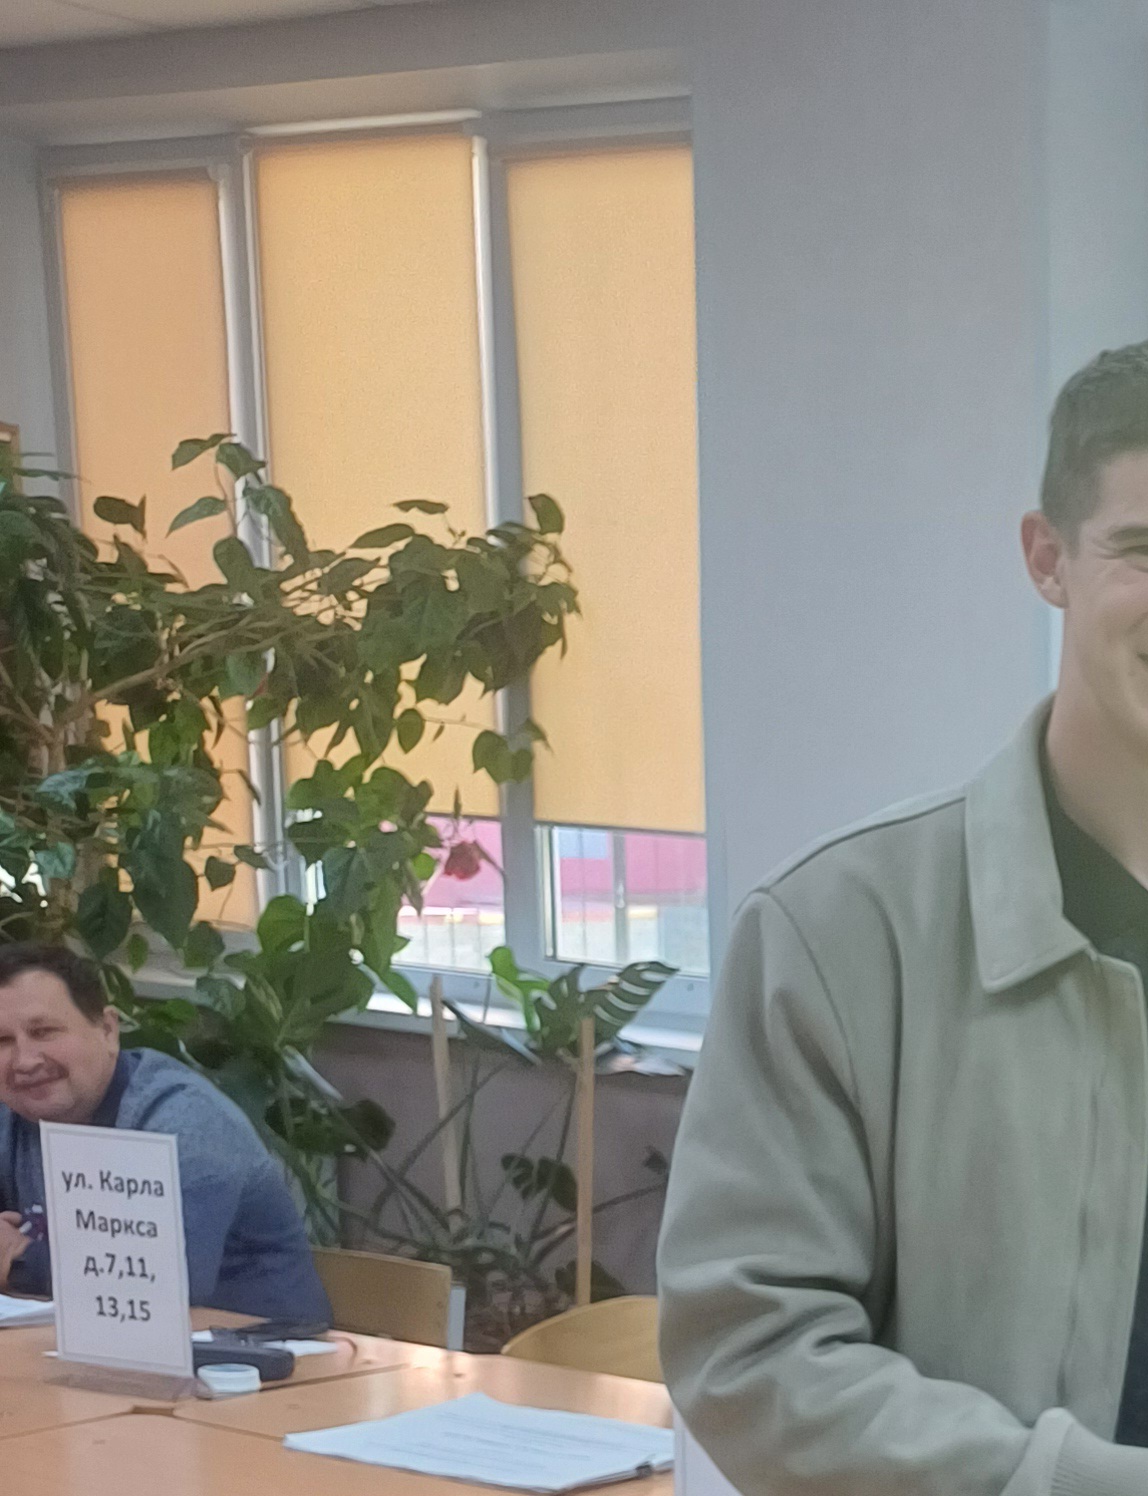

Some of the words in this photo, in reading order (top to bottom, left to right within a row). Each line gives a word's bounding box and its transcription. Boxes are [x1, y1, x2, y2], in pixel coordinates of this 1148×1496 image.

[61, 1170, 93, 1192] ул.
[100, 1170, 164, 1200] Карла
[76, 1208, 158, 1238] Маркса
[84, 1253, 156, 1282] д.7,11,
[96, 1295, 151, 1323] 13,15
